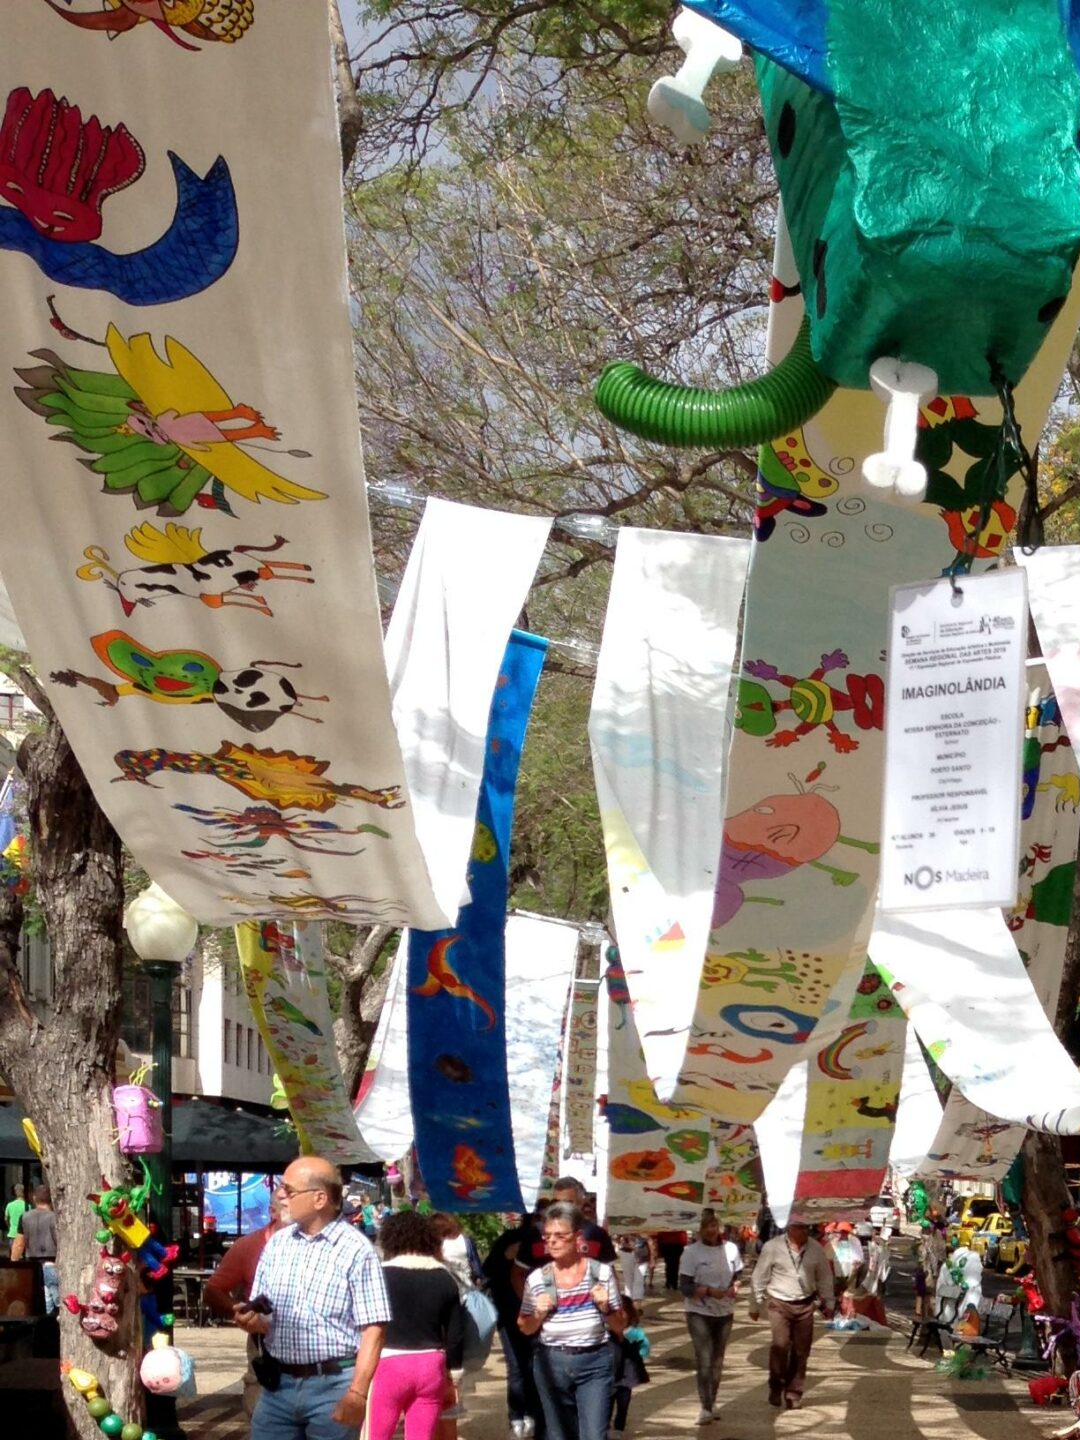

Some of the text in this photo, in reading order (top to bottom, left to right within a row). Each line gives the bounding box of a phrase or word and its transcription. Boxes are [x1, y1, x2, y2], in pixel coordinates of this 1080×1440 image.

[901, 677, 1007, 701] IMAGINOLÂNDIA
[940, 712, 964, 721] ESCOLA
[903, 865, 990, 890] NOS Madeira
